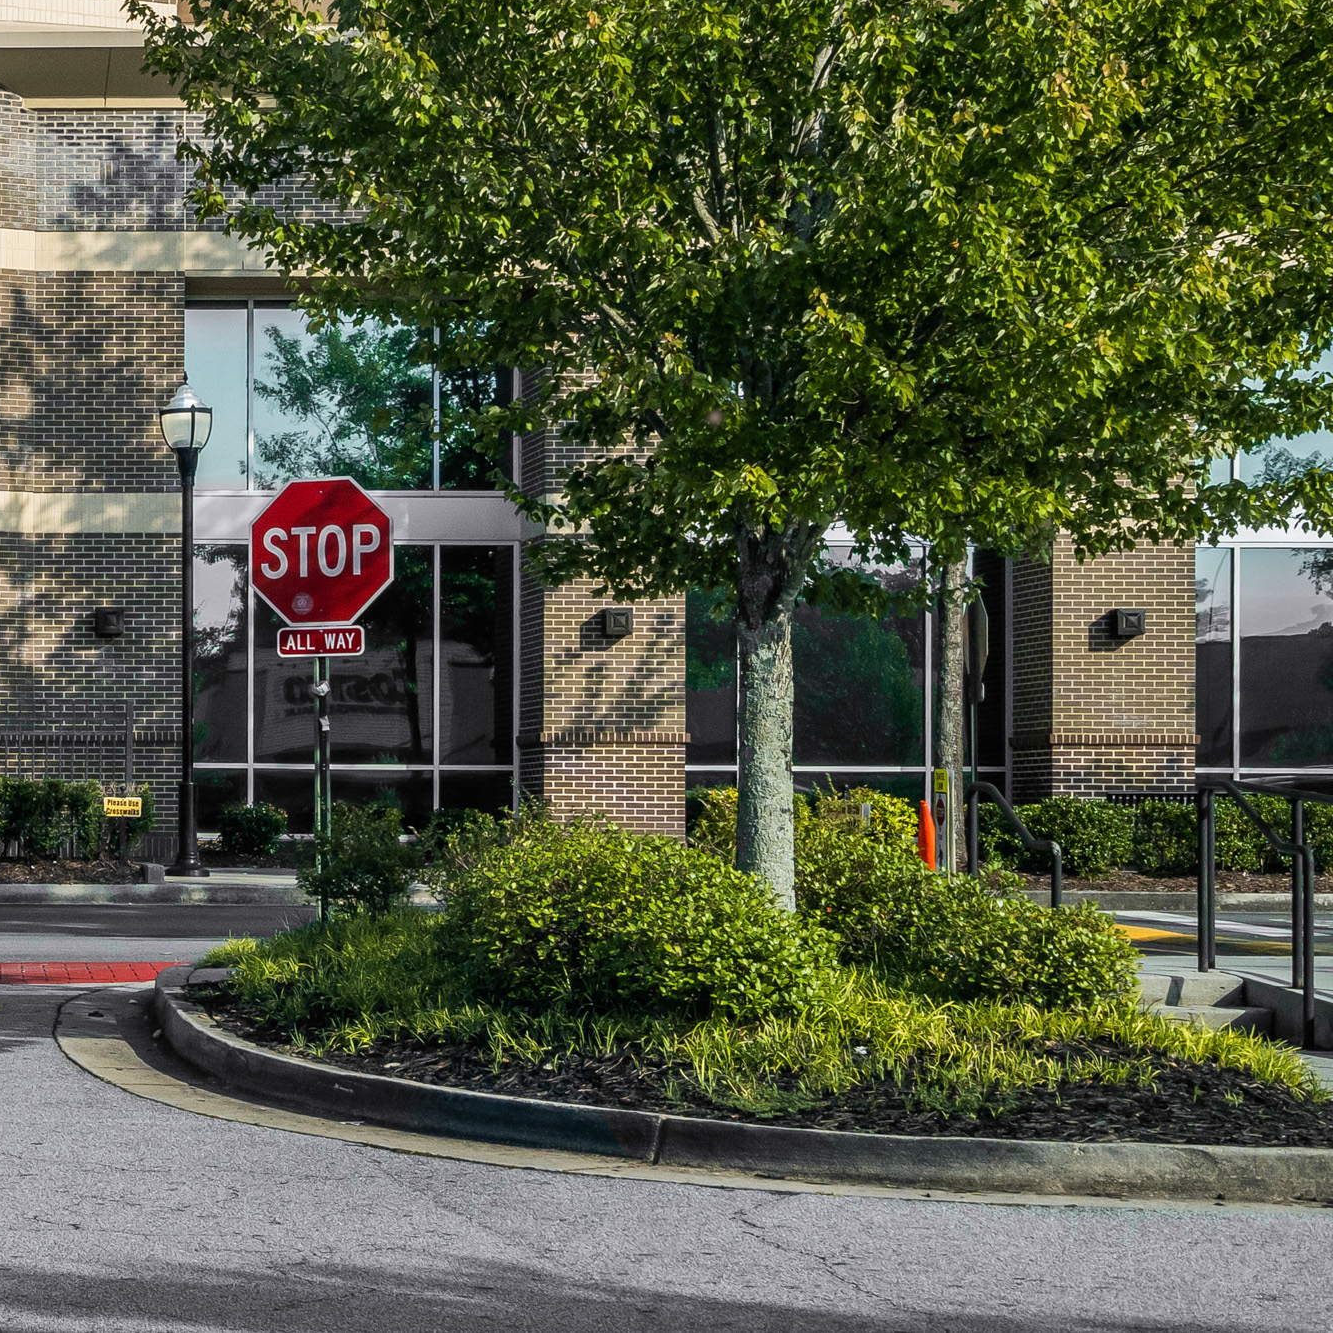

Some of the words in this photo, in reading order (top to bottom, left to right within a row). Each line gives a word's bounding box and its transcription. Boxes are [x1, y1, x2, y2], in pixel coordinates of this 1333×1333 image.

[260, 523, 381, 580] STOP
[286, 633, 316, 650] ALL
[324, 632, 355, 650] WAY
[107, 799, 127, 807] Please
[106, 807, 140, 816] Crosswalks
